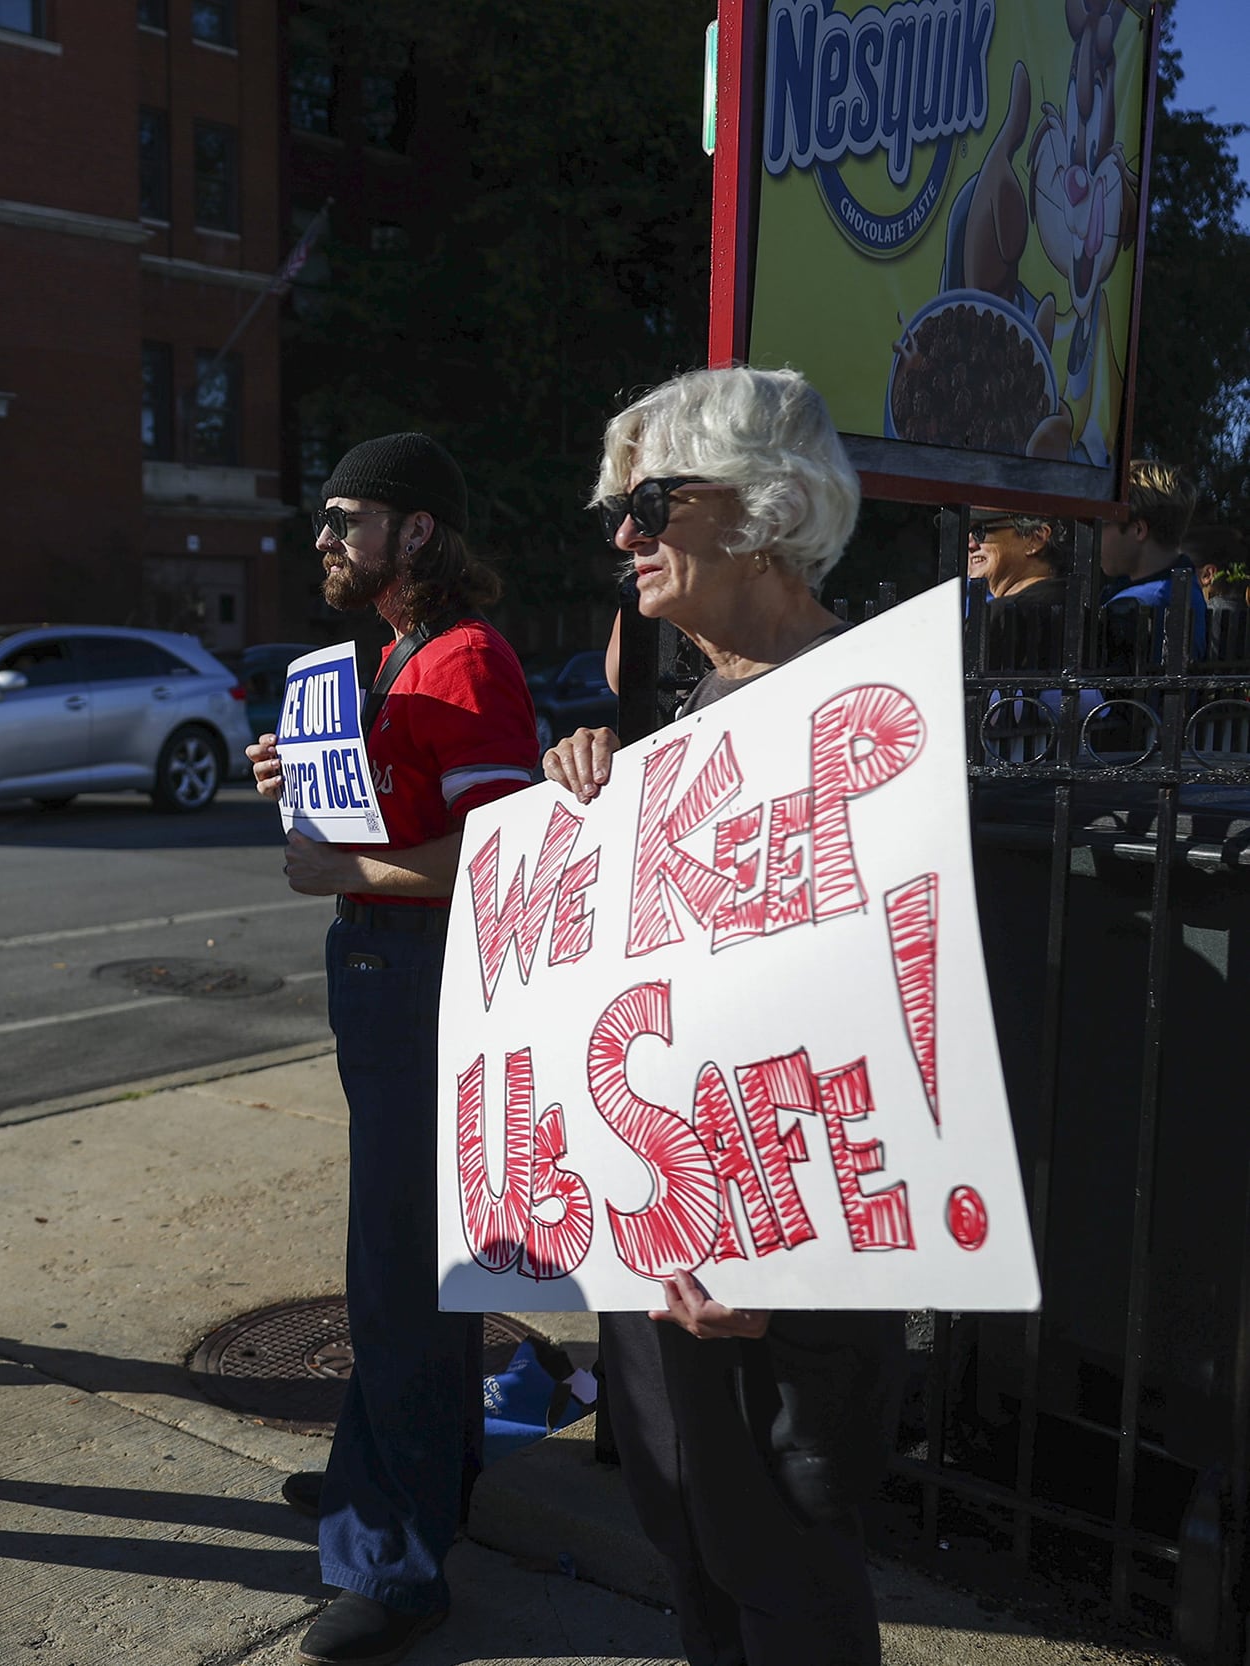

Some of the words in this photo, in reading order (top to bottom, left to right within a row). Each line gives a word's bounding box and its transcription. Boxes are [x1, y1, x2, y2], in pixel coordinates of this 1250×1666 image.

[767, 0, 993, 176] Nesquik
[840, 197, 905, 243] CHOCOLATE
[905, 180, 937, 231] TASTE
[280, 678, 303, 739] ICE
[303, 670, 341, 737] OUT!
[322, 747, 370, 809] ICE!
[372, 760, 394, 795] rs
[626, 684, 927, 957] KEEP
